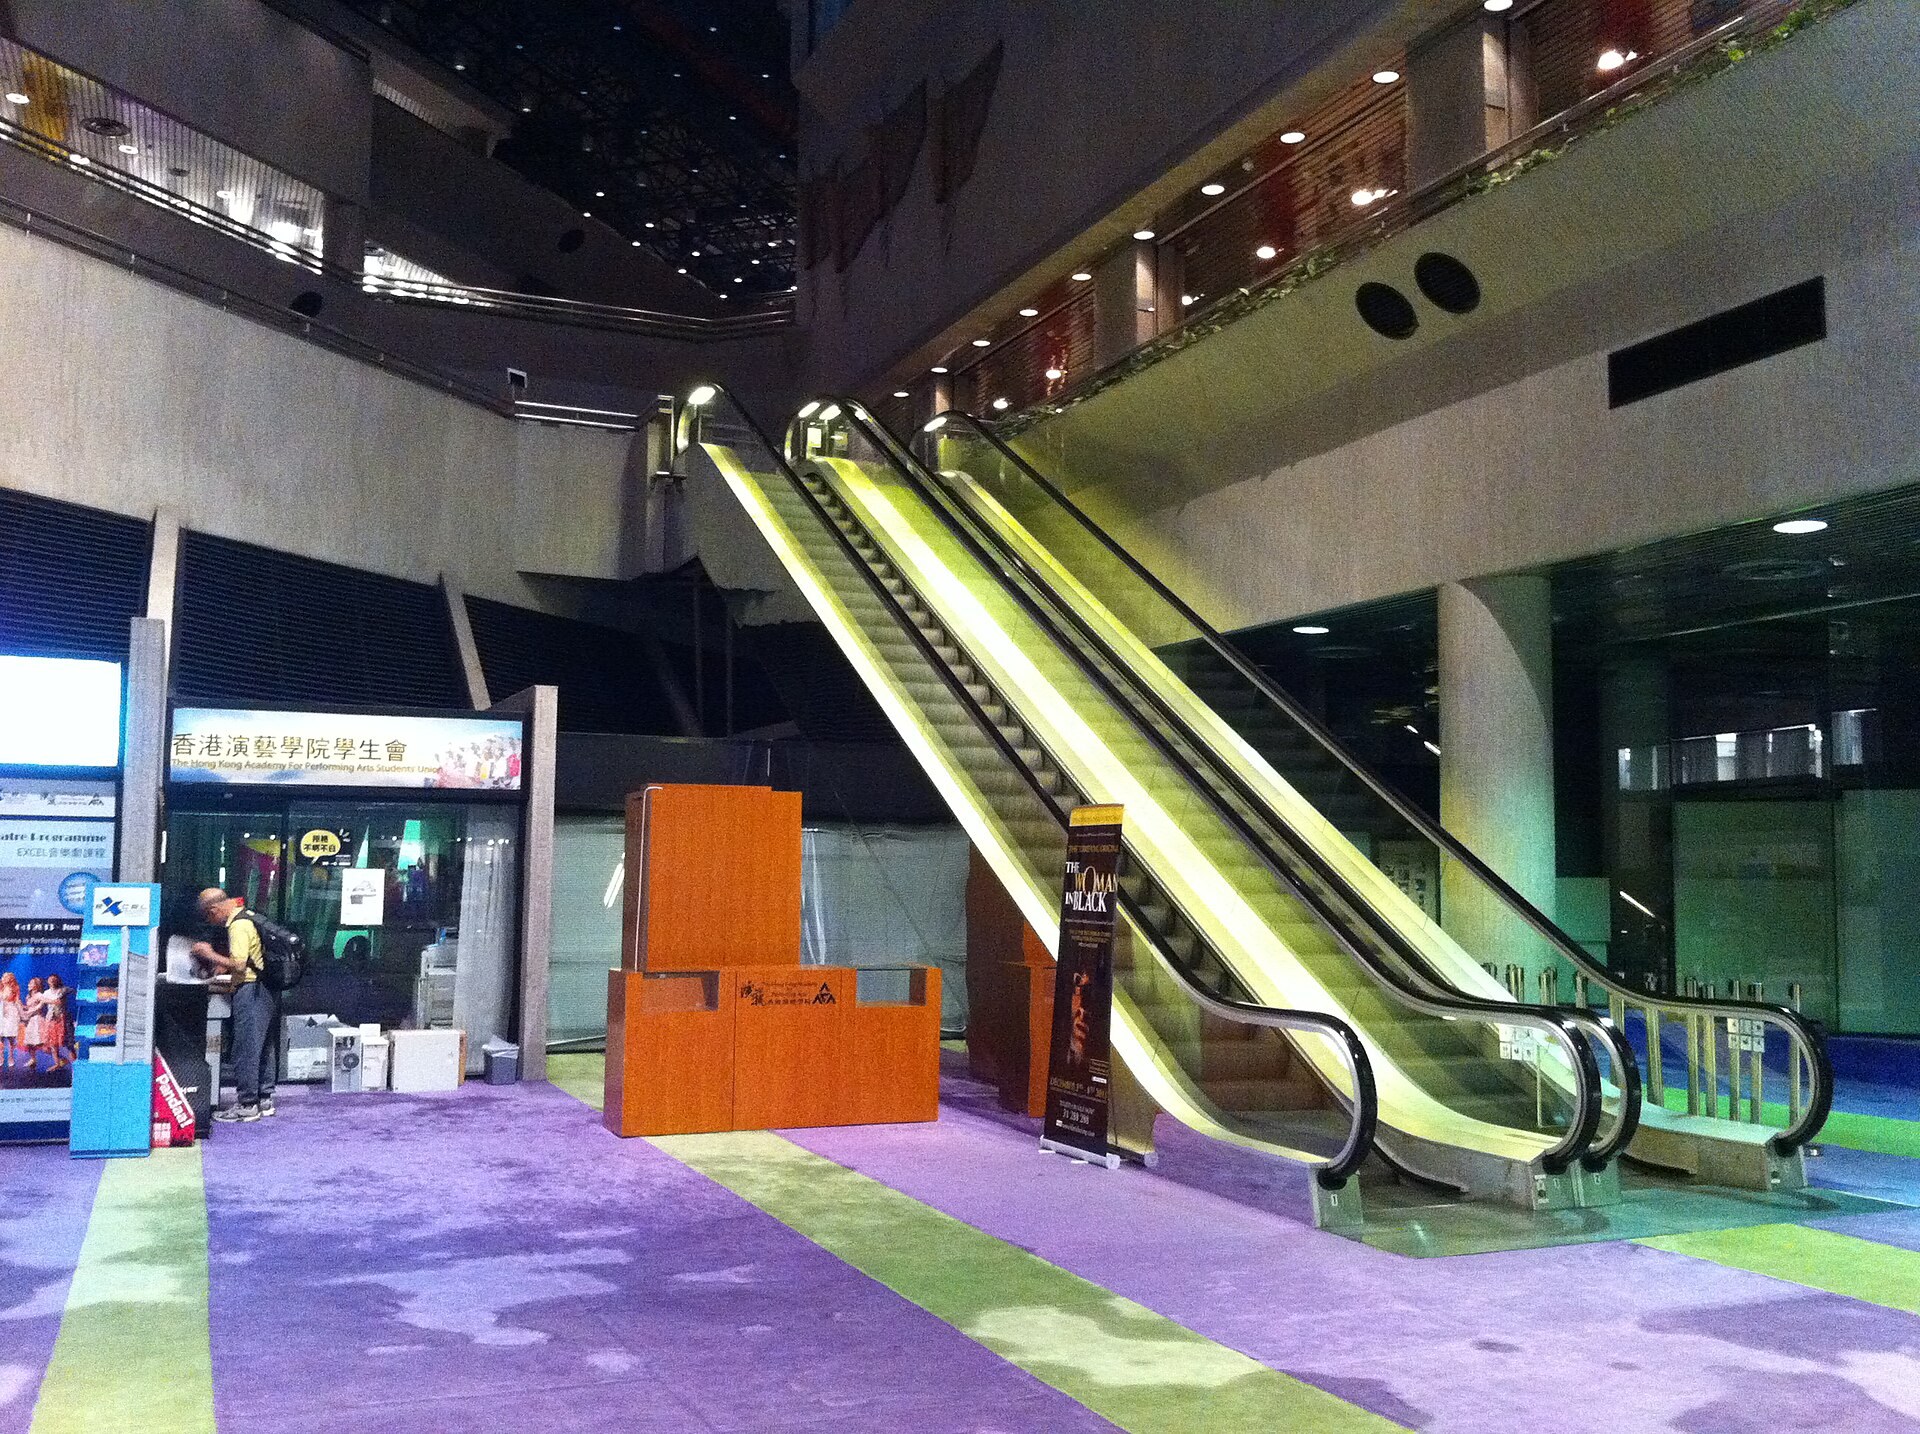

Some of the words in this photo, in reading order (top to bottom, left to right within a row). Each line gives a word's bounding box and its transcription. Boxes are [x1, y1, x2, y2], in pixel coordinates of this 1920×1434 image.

[173, 733, 407, 761] 香港演藝學院學生會
[172, 759, 188, 768] The
[191, 760, 216, 769] Hong
[219, 760, 242, 770] Kong
[245, 761, 286, 770] Academy
[289, 762, 303, 770] For
[305, 762, 354, 773] Performing
[357, 763, 374, 772] Arts
[418, 766, 443, 774] Union
[1066, 861, 1080, 874] THE
[1075, 866, 1118, 895] WOMAN
[1065, 892, 1074, 905] IN
[1073, 891, 1107, 912] BLACK
